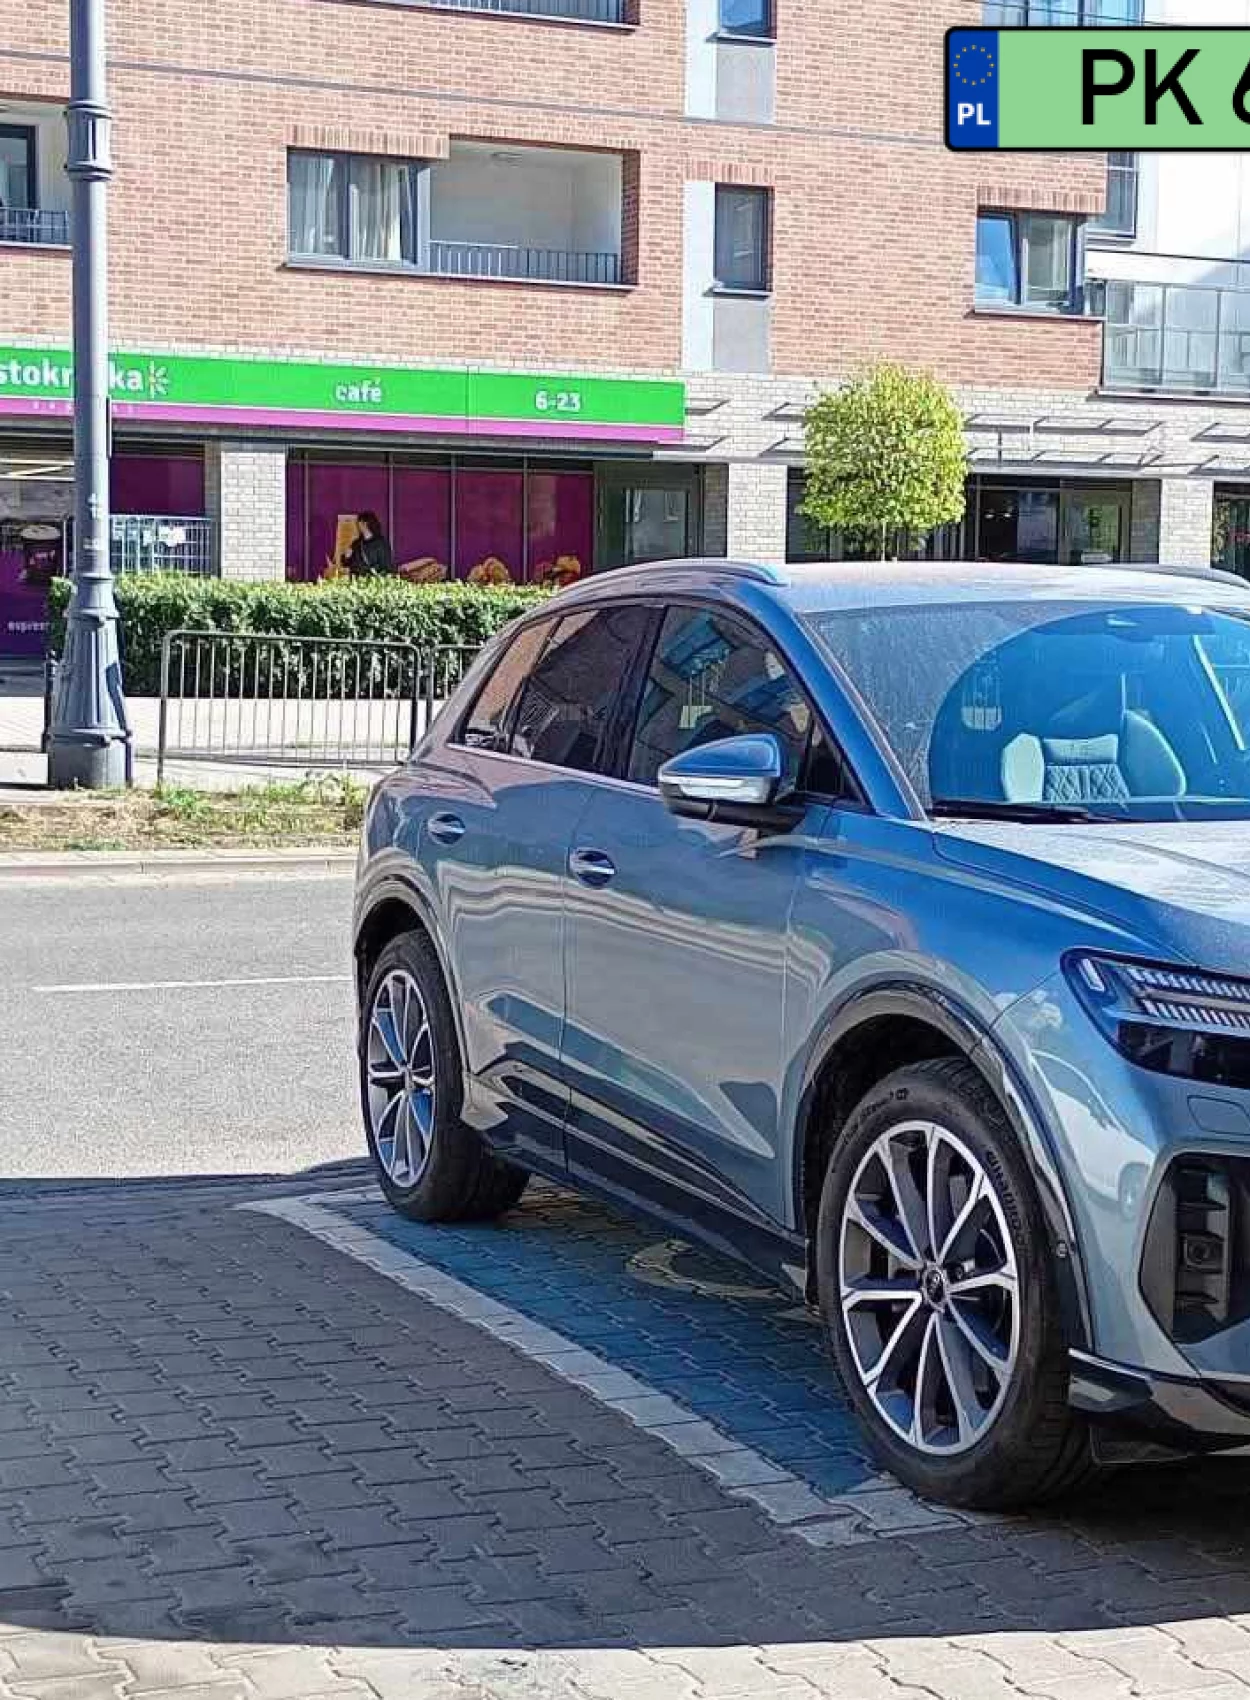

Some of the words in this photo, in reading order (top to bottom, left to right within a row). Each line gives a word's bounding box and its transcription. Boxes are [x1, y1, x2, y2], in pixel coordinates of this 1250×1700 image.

[0, 358, 144, 390] stokrka
[335, 377, 382, 403] café
[535, 390, 581, 412] 6-23
